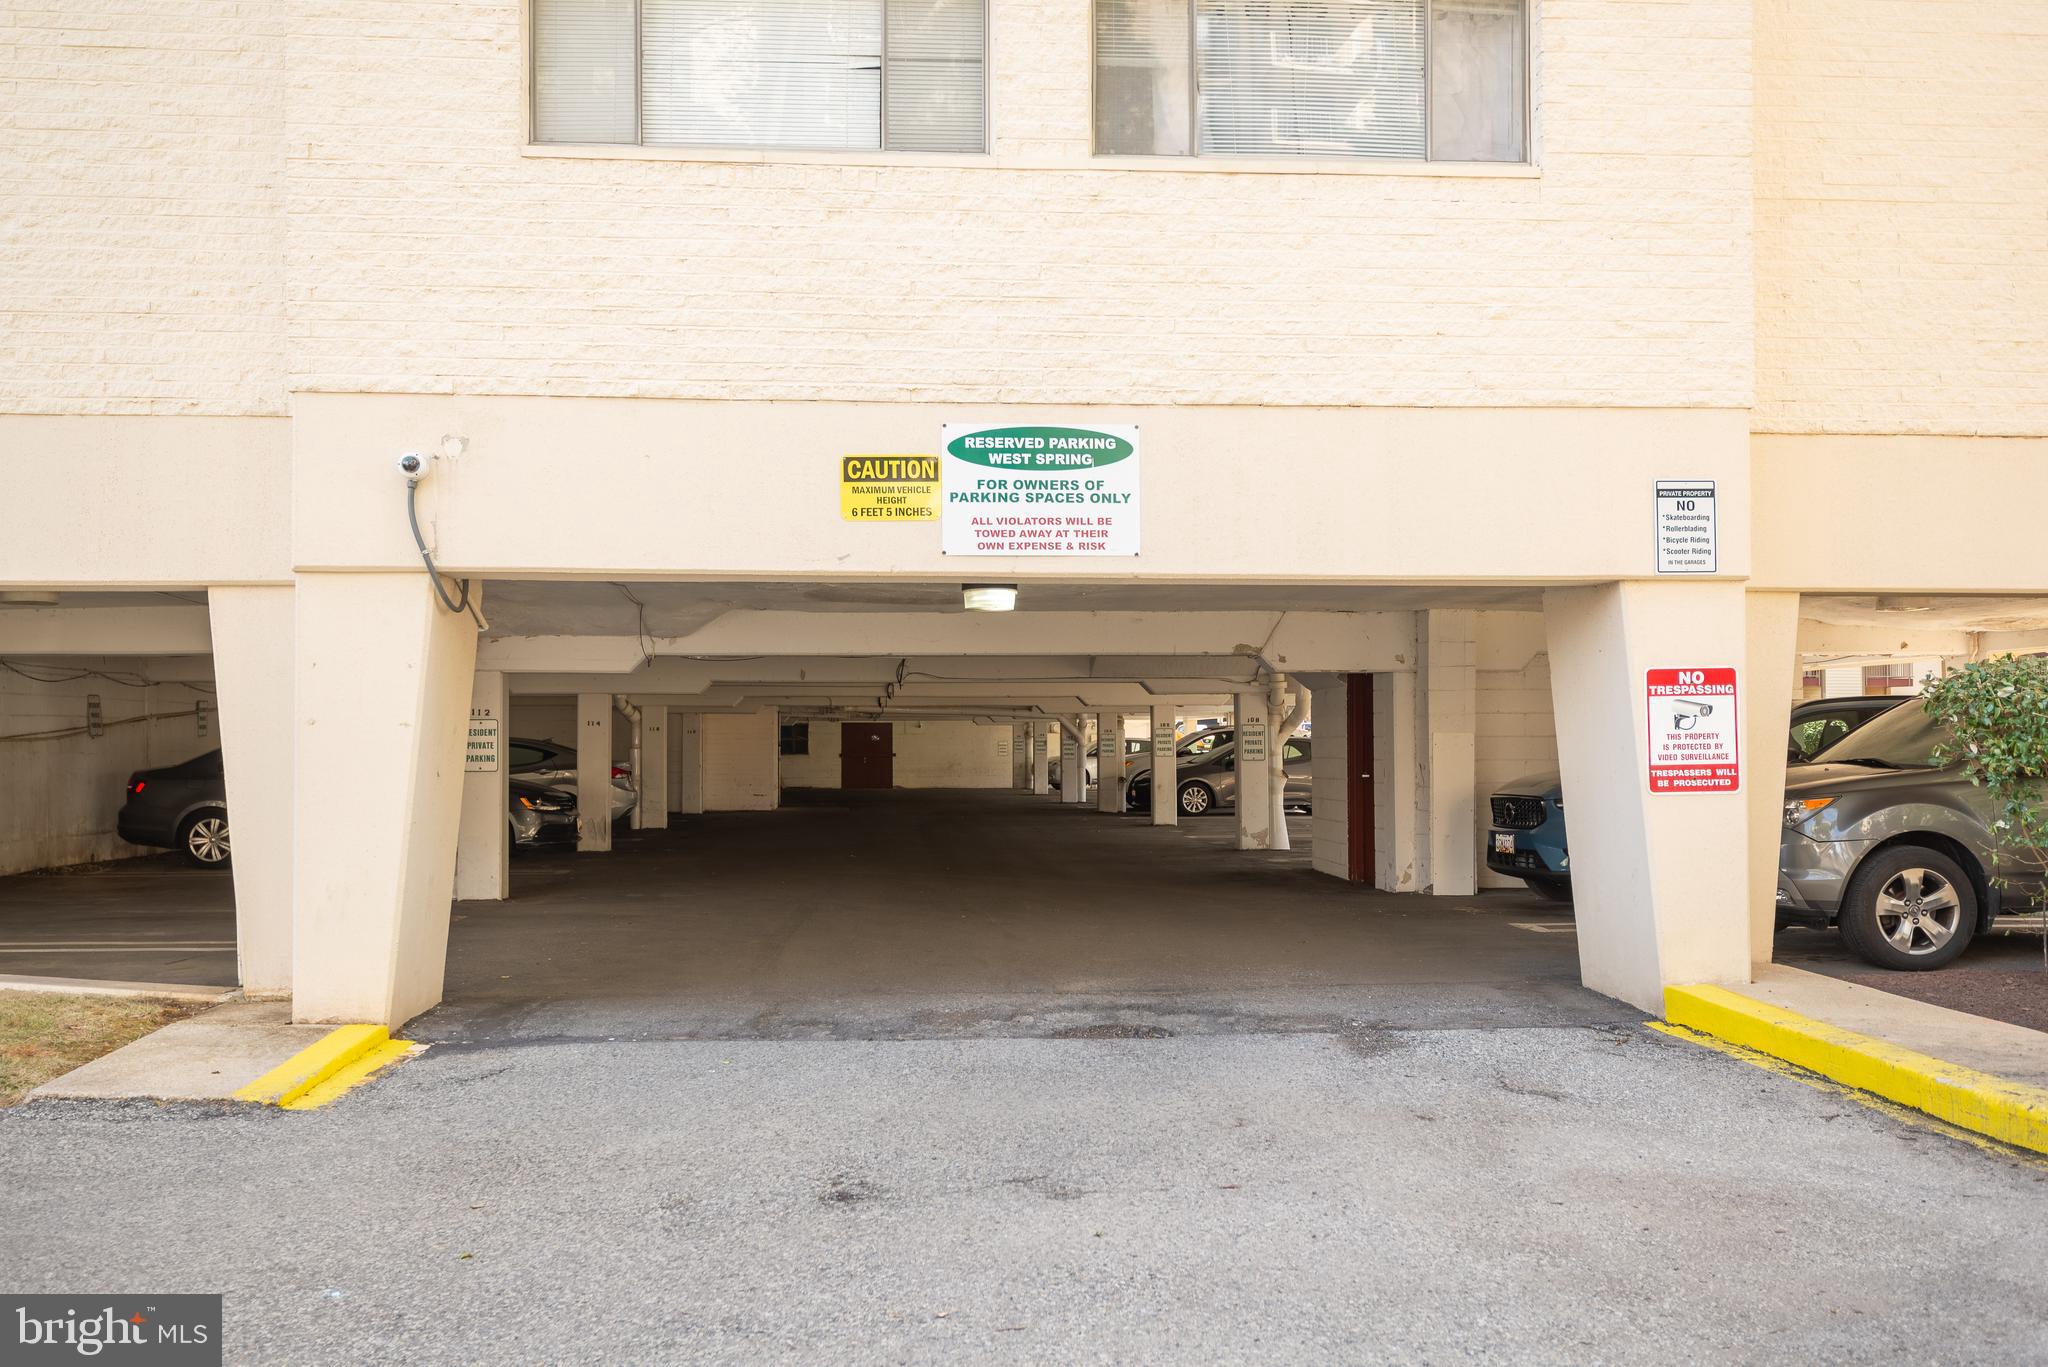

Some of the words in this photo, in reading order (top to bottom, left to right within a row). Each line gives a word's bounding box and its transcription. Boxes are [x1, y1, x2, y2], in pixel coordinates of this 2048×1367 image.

[964, 437, 1045, 449] RESERVED
[1049, 438, 1117, 450] PARKING
[988, 453, 1032, 464] WEST
[1035, 453, 1093, 465] SPRING
[847, 460, 935, 479] CAUTION
[977, 479, 1008, 490] FOR
[1013, 479, 1080, 491] OWNERS
[1084, 480, 1105, 491] OF
[851, 486, 895, 494] MAXIMUM
[897, 486, 932, 494] VEHICLE
[876, 496, 907, 505] HEIGHT
[950, 492, 1020, 503] PARKING
[1025, 492, 1085, 504] SPACES
[1090, 493, 1132, 504] ONLY
[1676, 500, 1695, 511] NO
[852, 507, 858, 517] 6
[860, 507, 884, 517] FEET
[886, 507, 893, 517] 5
[895, 507, 933, 517] INCHES
[971, 517, 993, 526] ALL
[996, 517, 1062, 526] VIOLATORS
[1065, 517, 1094, 526] WILL
[1097, 517, 1113, 526] BE
[974, 529, 1016, 538] TOWED
[1019, 529, 1052, 538] AWAY
[1055, 529, 1070, 538] AT
[1073, 529, 1109, 538] THEIR
[977, 542, 1005, 551] OWN
[1008, 542, 1062, 551] EXPENSE
[1066, 542, 1074, 551] &
[1078, 542, 1106, 551] RISK
[1678, 671, 1705, 685] NO
[1648, 684, 1734, 695] TRESPASSING
[471, 708, 490, 716] 112
[468, 728, 497, 737] ESIDENT
[466, 741, 495, 750] PRIVATE
[1662, 743, 1669, 751] IS
[465, 754, 496, 763] PARKING
[1657, 753, 1678, 761] VIDEO
[1650, 768, 1712, 777] TRESPASSERS
[1715, 768, 1737, 776] WILL
[1673, 778, 1732, 787] PROSECUTED
